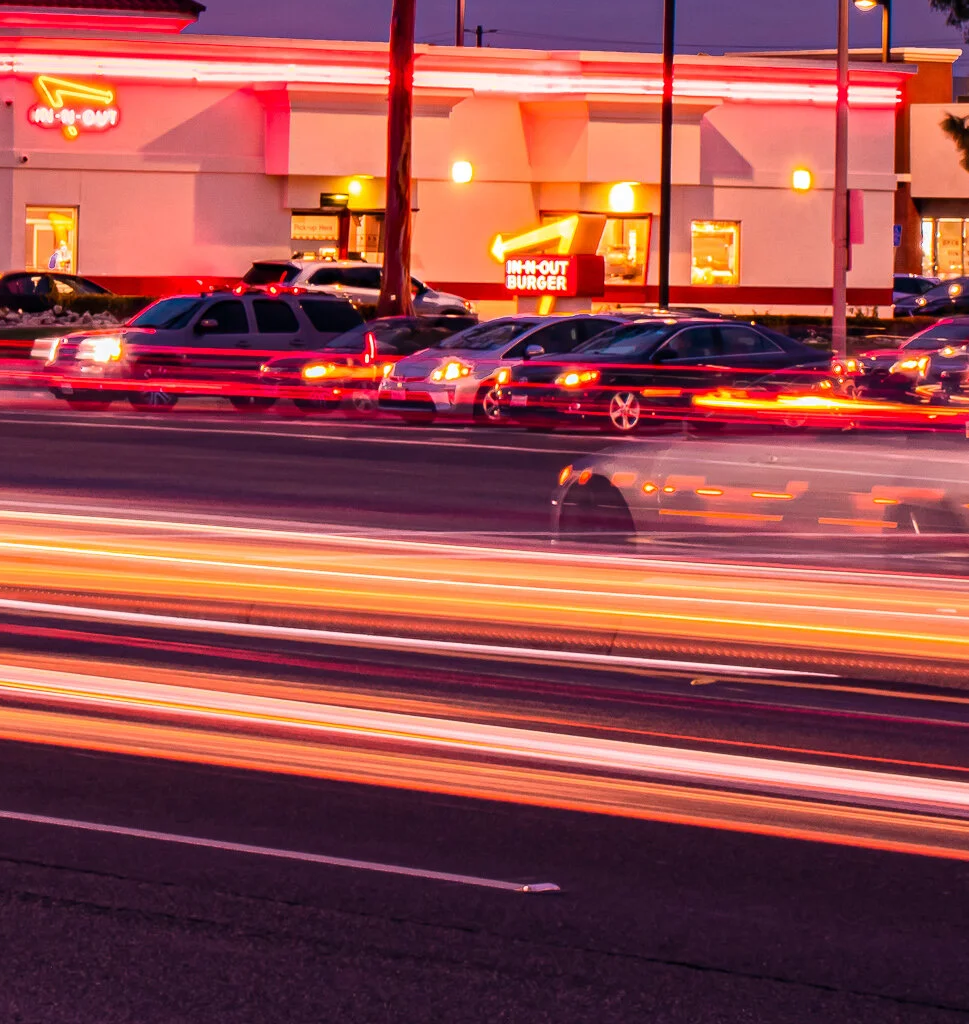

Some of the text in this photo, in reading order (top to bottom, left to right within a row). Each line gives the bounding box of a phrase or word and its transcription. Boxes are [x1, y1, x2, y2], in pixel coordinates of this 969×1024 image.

[32, 107, 118, 127] IN-N-OUT
[506, 260, 569, 275] IN-N-OUT
[506, 275, 567, 290] BURGER
